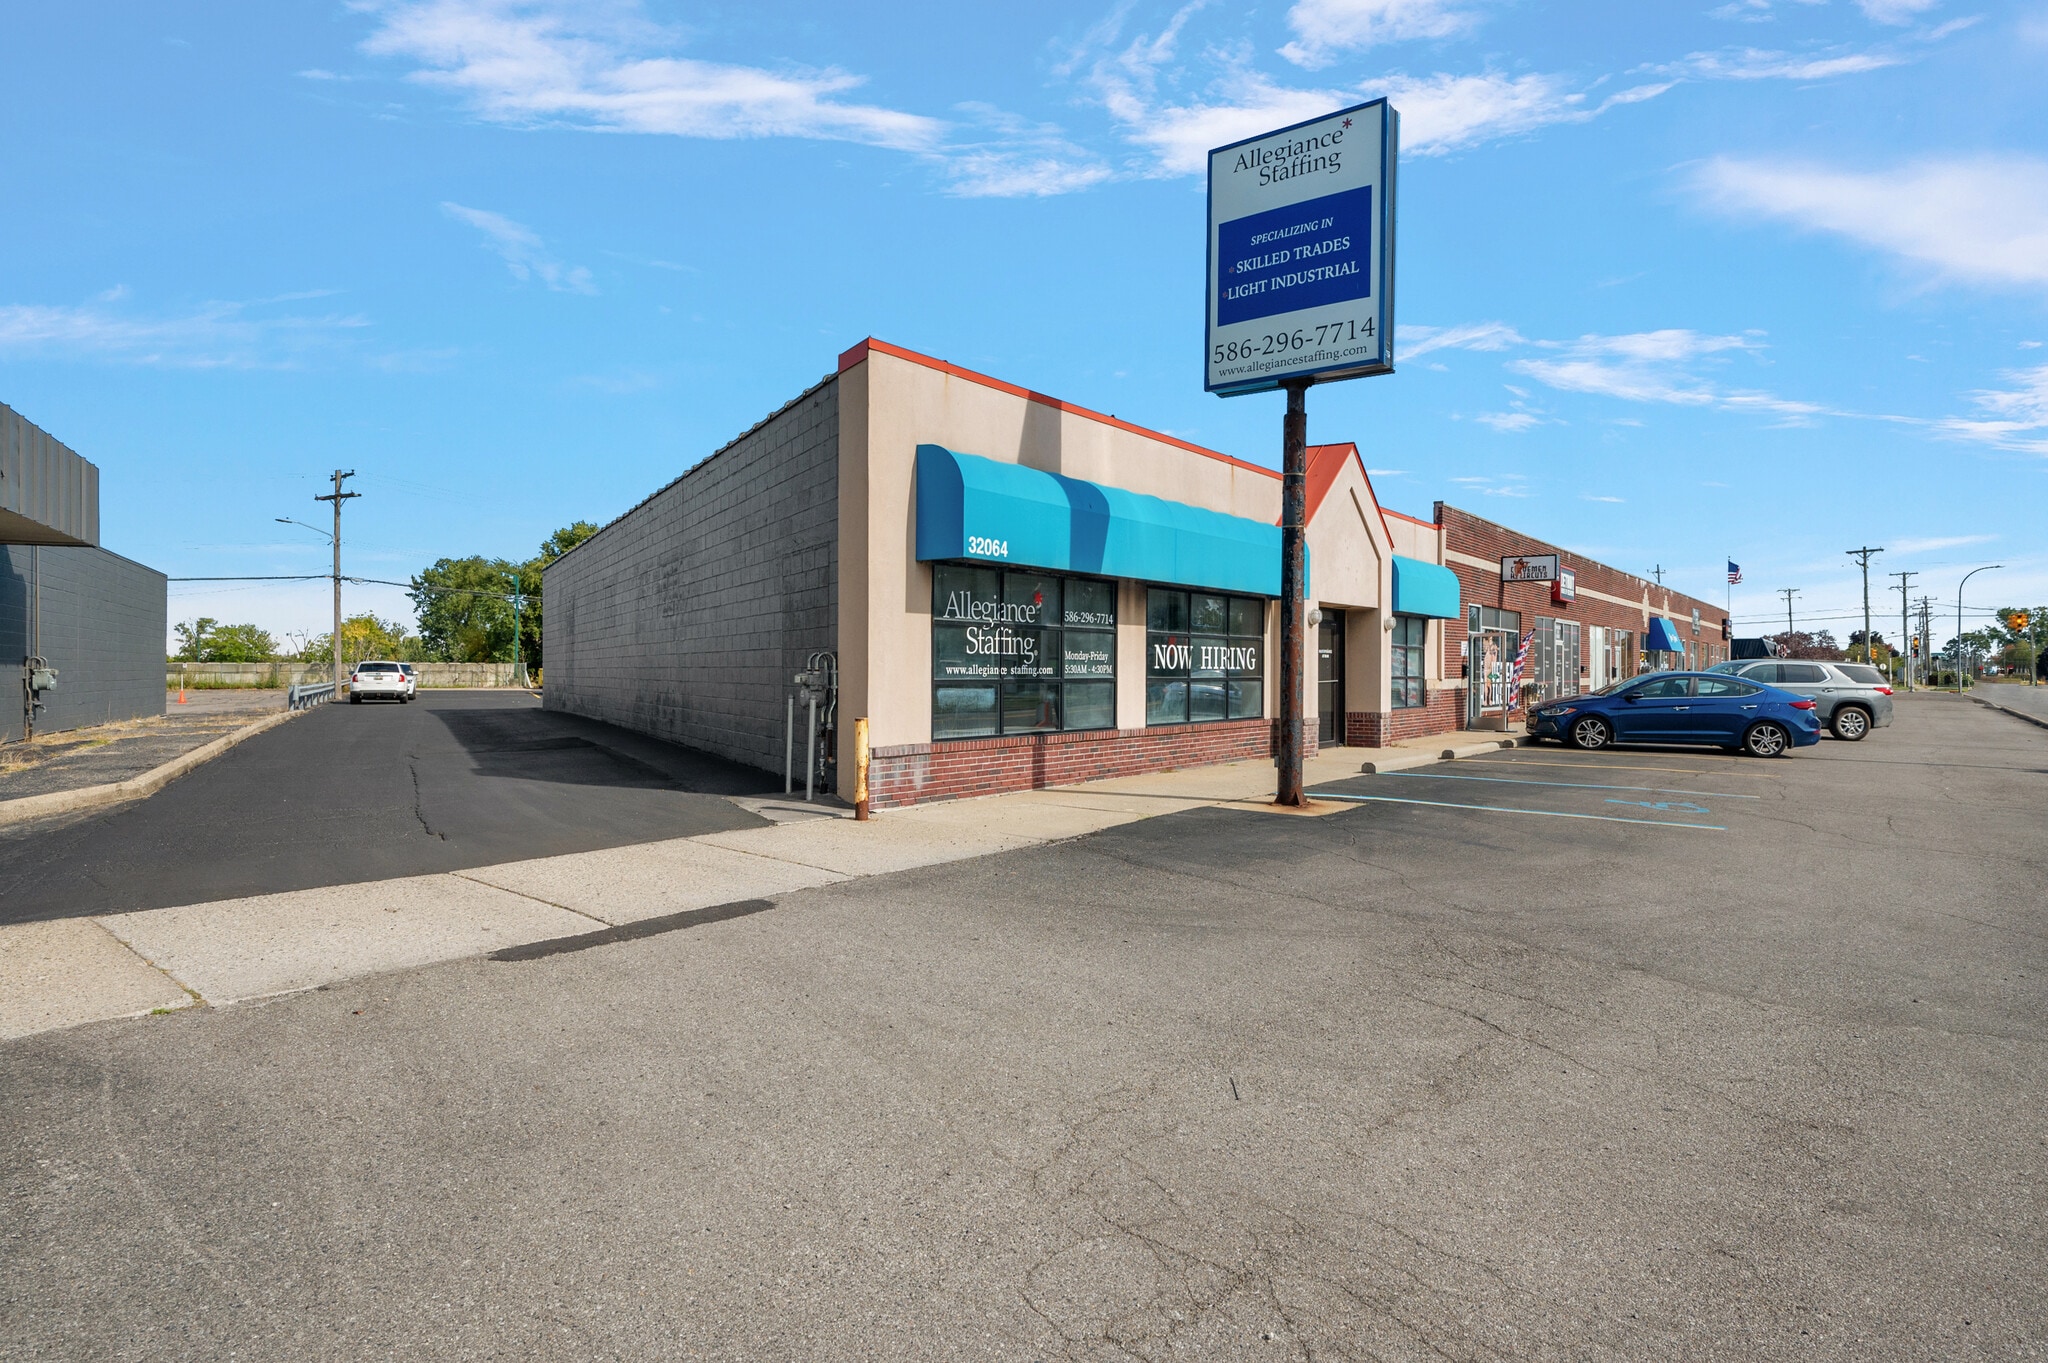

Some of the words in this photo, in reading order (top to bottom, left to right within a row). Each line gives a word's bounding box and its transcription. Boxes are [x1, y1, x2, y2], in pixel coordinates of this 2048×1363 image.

[1233, 128, 1344, 174] Allegiance
[1259, 151, 1342, 187] Staffing
[1250, 220, 1319, 246] SPECIALIZING
[1321, 216, 1334, 230] IN
[1236, 249, 1291, 274] SKILLED
[1293, 236, 1351, 261] TRADES
[1227, 279, 1268, 301] LIGHT
[1270, 260, 1360, 291] INDUSTRIAL
[1213, 316, 1376, 364] 586-296-7714
[1218, 344, 1368, 378] www.allegiancestaffing.com
[967, 535, 1009, 558] 32064
[943, 590, 1036, 630] Allegiance
[1064, 611, 1114, 625] 586-296-7714
[966, 626, 1036, 665] Staffing
[1064, 650, 1109, 664] Monday-Friday
[1153, 644, 1194, 670] NOW
[1200, 645, 1257, 671] HIRING
